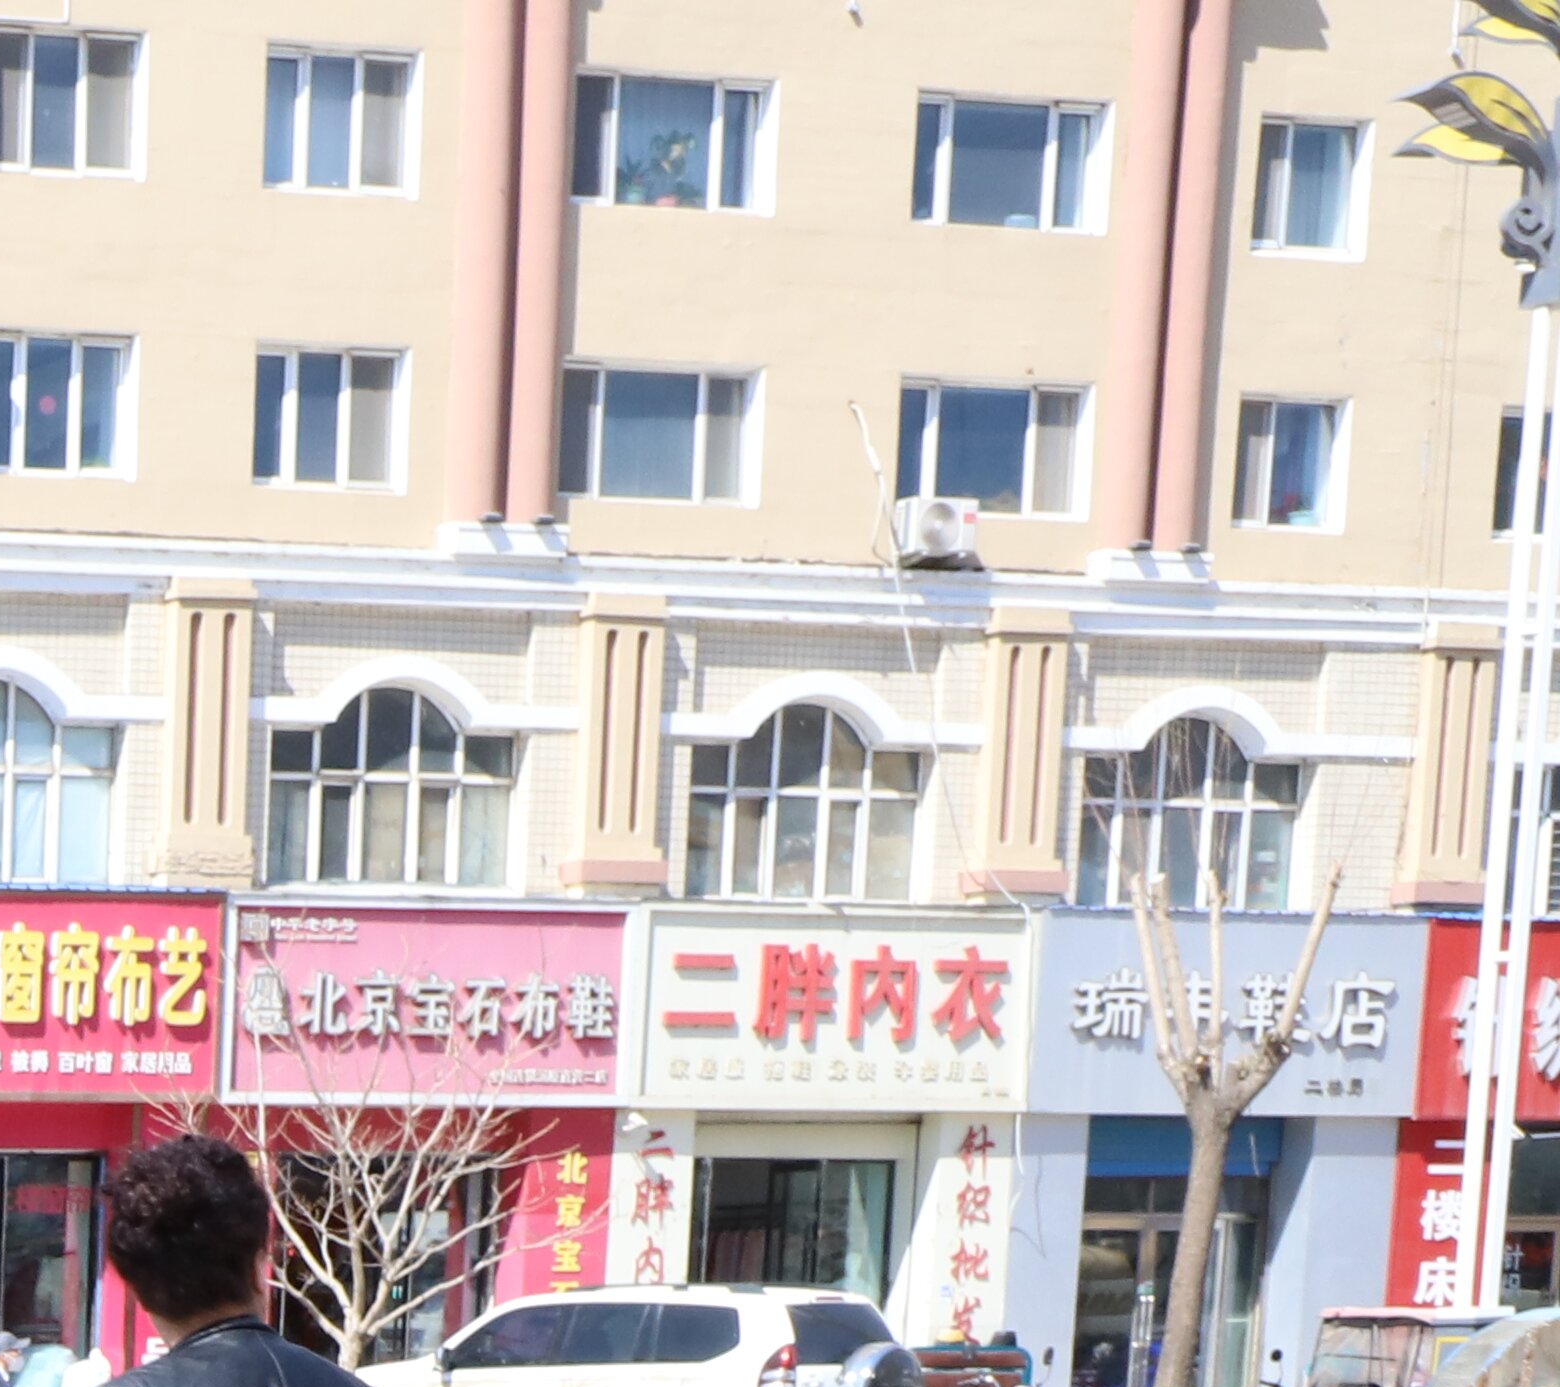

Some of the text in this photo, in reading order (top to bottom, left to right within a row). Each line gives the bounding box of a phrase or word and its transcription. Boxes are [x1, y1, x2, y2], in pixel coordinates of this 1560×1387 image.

[298, 969, 614, 1041] 北京宝石布鞋
[663, 943, 1010, 1042] 二胖内衣
[1070, 968, 1396, 1049] 瑞鞋店
[57, 1051, 114, 1075] 百叶窗
[121, 1051, 192, 1075] 家居用品
[631, 1129, 675, 1286] 二胖内
[950, 1123, 996, 1347] 针织批发
